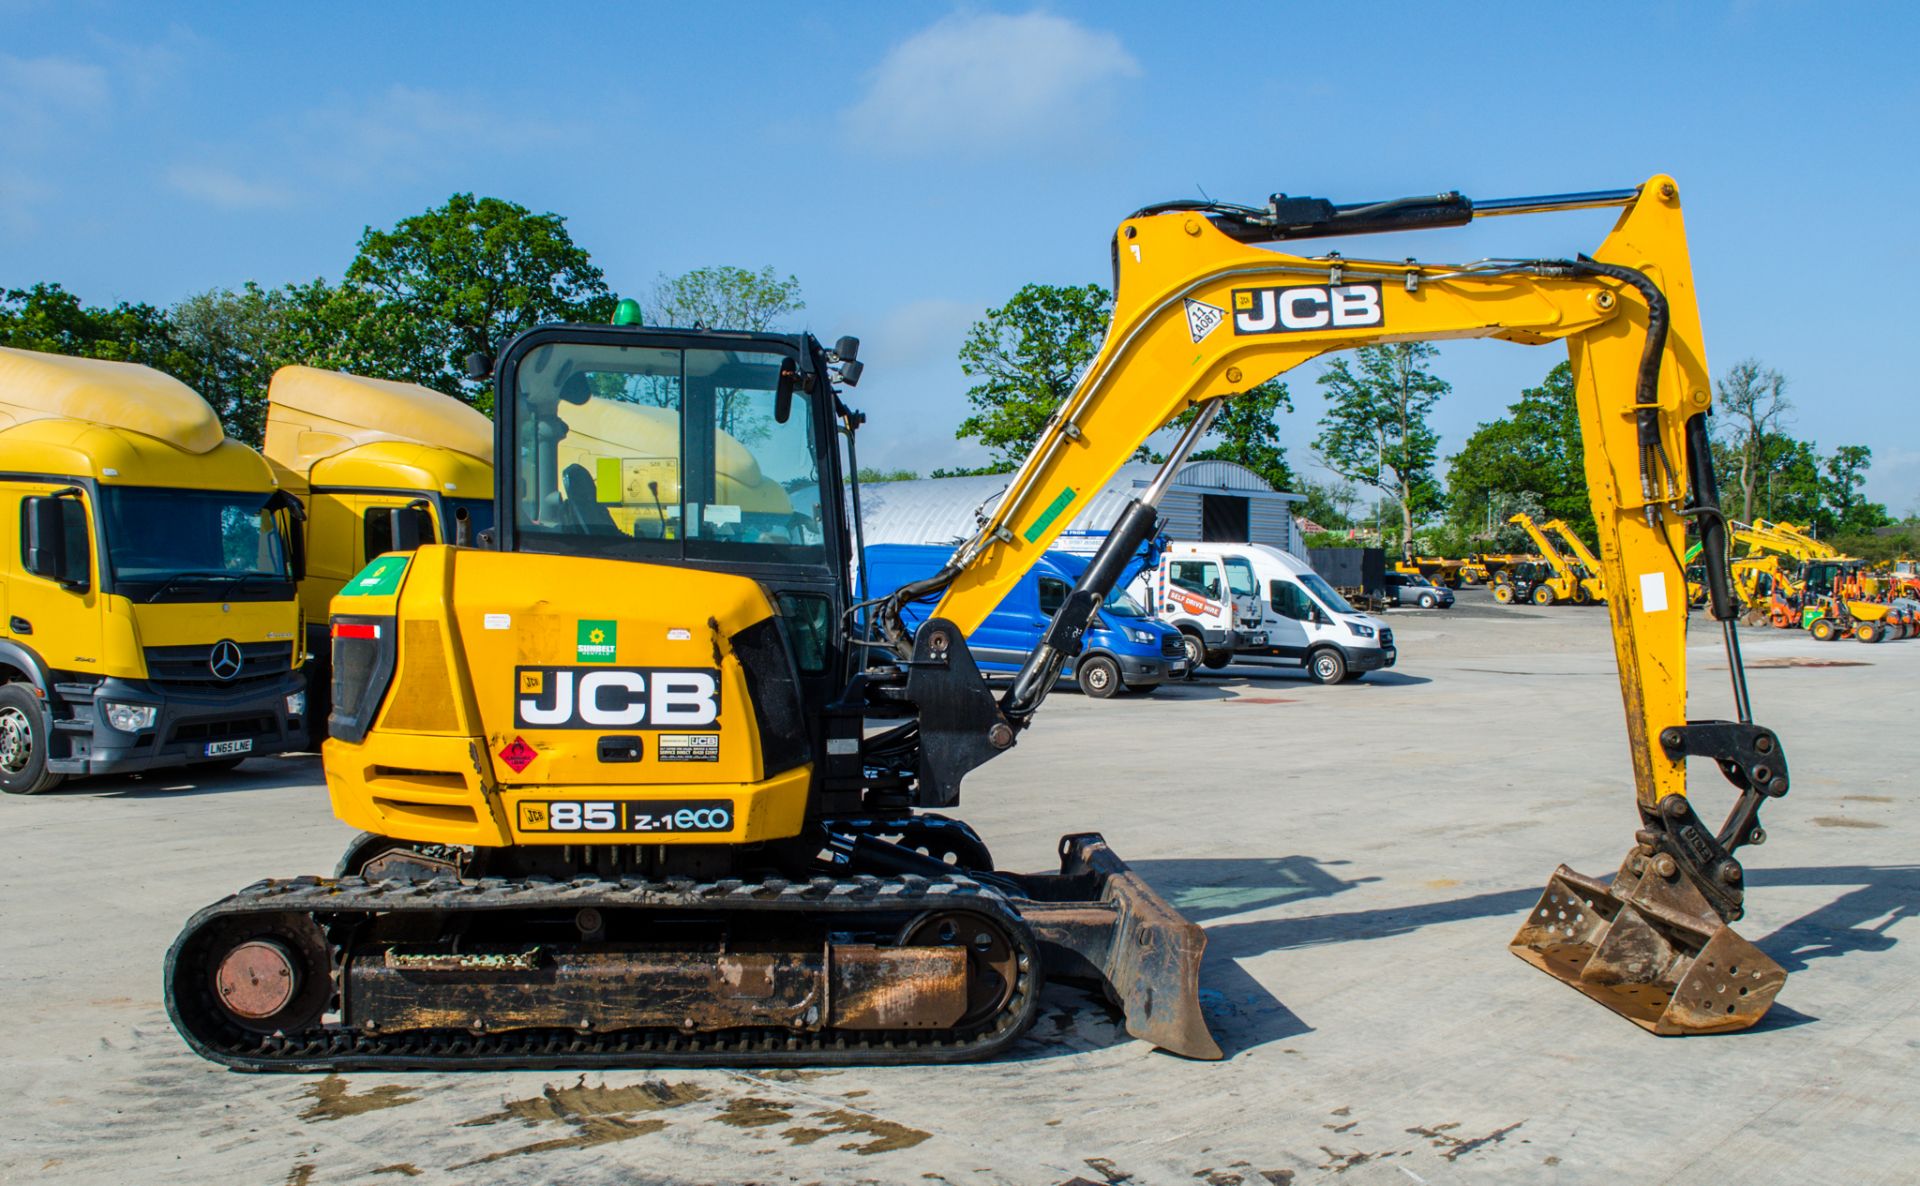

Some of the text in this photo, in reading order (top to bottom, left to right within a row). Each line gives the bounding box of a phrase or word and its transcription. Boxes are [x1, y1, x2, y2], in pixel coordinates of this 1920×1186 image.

[1192, 306, 1206, 320] 11
[1236, 286, 1380, 331] JCB
[1185, 597, 1204, 610] DRIVE
[577, 644, 616, 653] SUNBELT
[520, 671, 718, 725] JCB
[210, 740, 250, 754] LN65 LNE
[527, 808, 545, 824] JCB
[550, 802, 616, 830] 85
